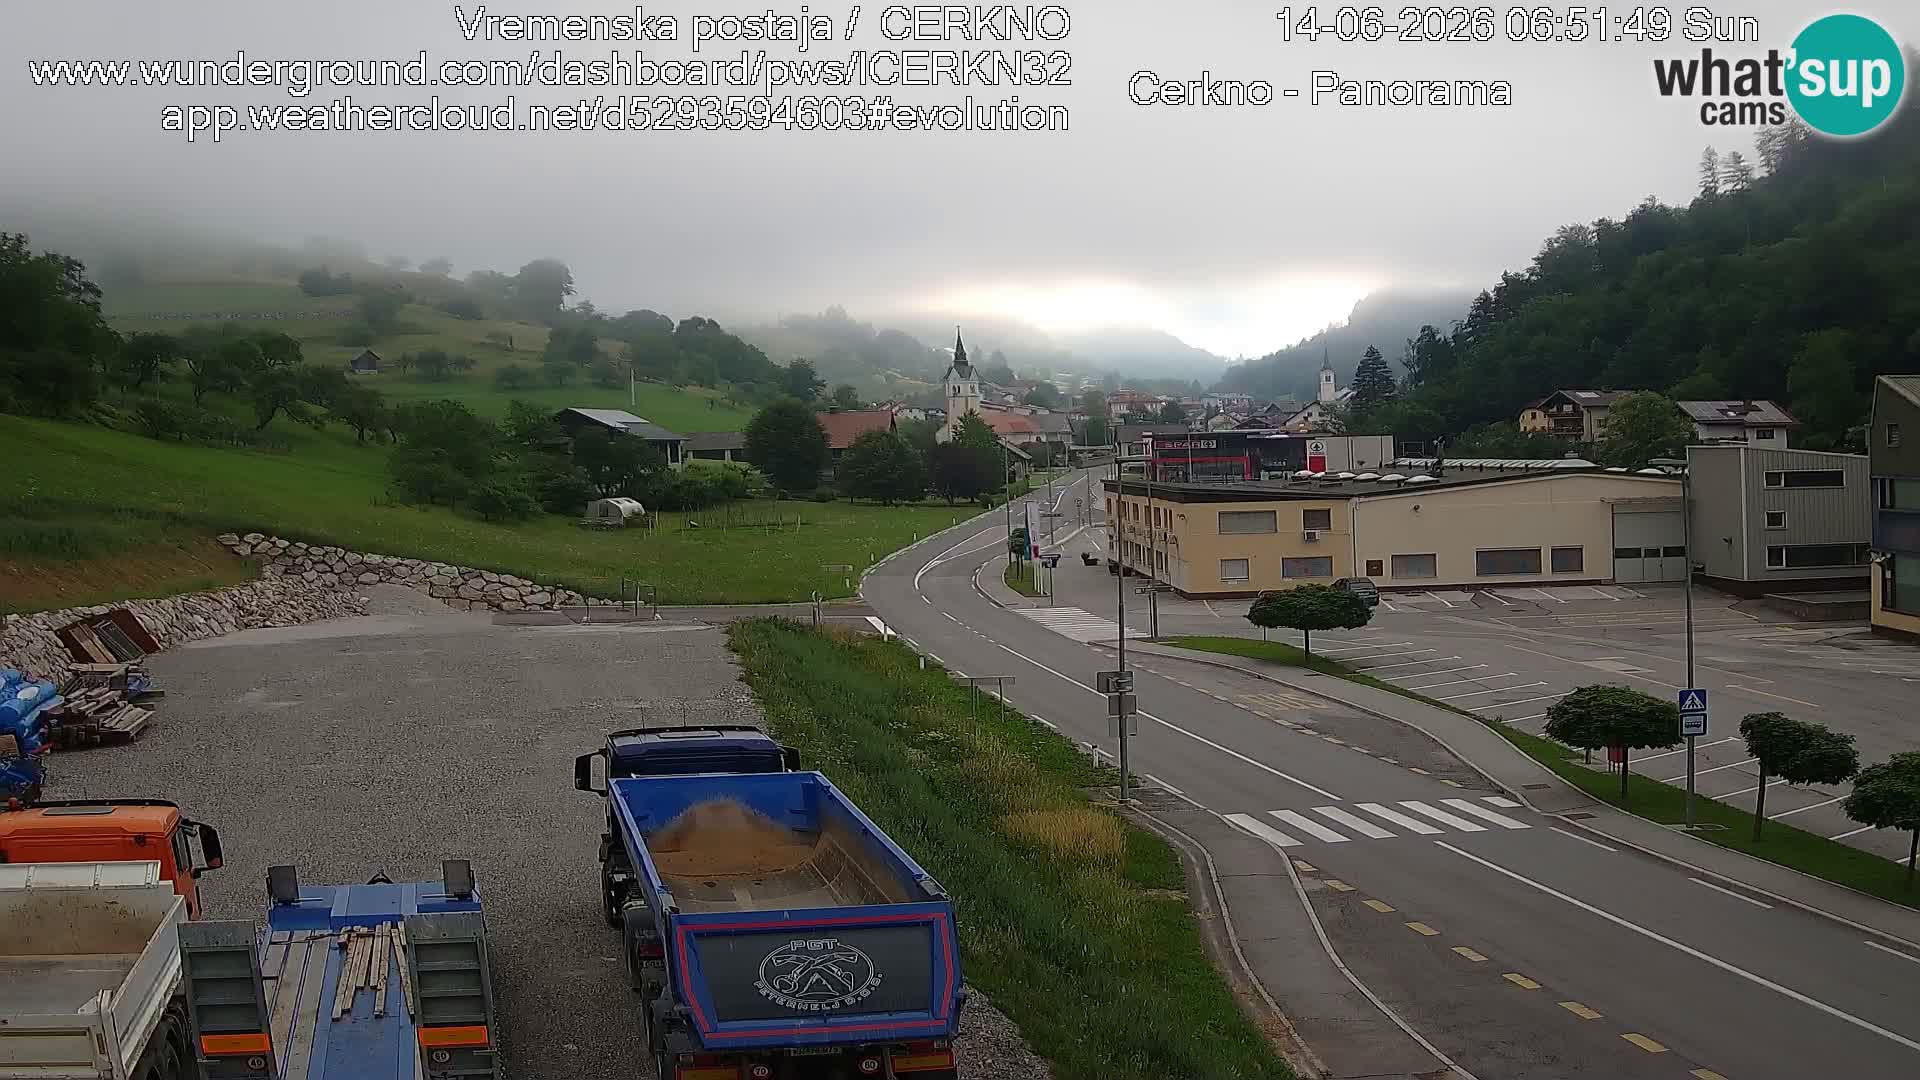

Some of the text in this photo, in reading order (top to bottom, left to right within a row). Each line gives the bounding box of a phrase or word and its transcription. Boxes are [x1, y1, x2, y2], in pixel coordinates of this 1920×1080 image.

[1165, 441, 1201, 449] SPAR
[790, 939, 838, 951] PGT
[250, 1059, 263, 1069] 40
[864, 1060, 877, 1070] 80
[754, 1066, 768, 1076] 70
